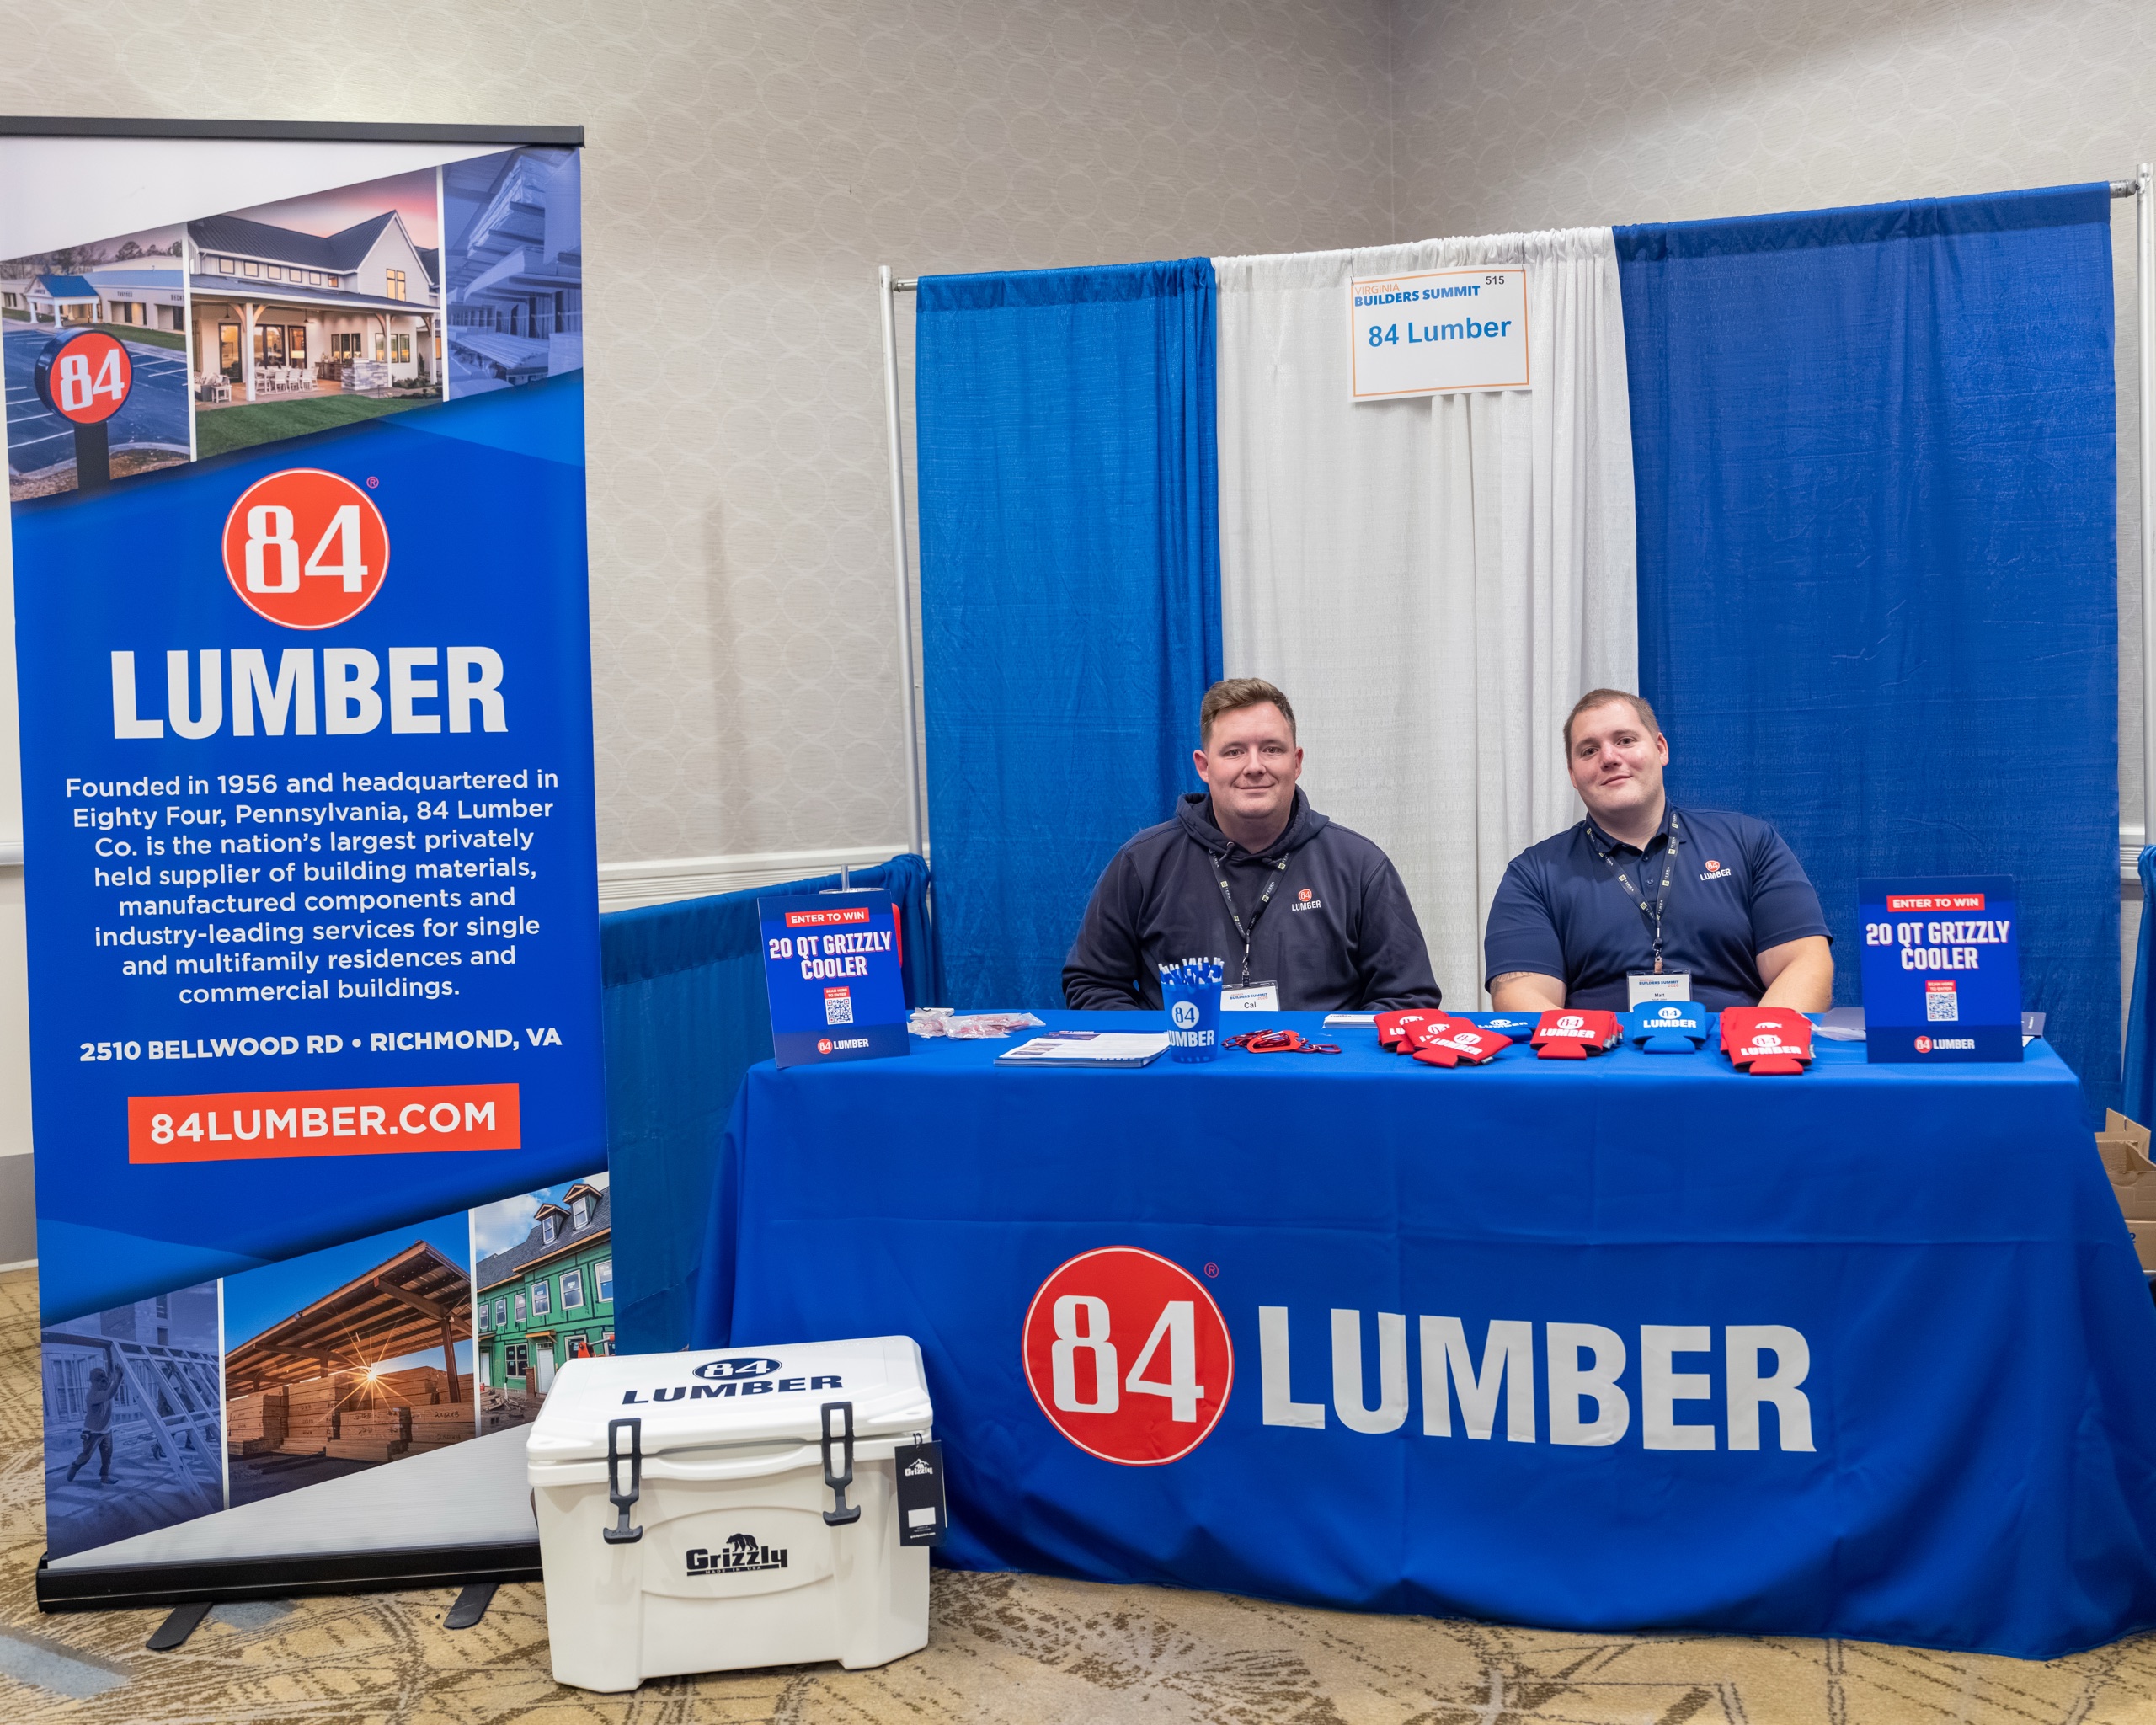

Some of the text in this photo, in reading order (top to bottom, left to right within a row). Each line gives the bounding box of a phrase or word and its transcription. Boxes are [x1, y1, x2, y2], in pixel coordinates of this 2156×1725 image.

[1355, 283, 1400, 296] VIRGINIA
[1486, 275, 1505, 286] 515
[1354, 286, 1481, 307] BUILDERS SUMMIT
[1369, 317, 1512, 347] 84 Lumber
[60, 349, 125, 412] 84
[245, 505, 368, 594] 84
[111, 646, 508, 740] LUMBER
[66, 769, 558, 798] Founded in 1956 and headquartered in
[73, 798, 553, 830] Eighty Four, Pennsylvania, 84 Lumber
[95, 828, 534, 857] Co. is the nation’s largest privately
[94, 857, 536, 888] held supplier of building materials,
[1700, 868, 1732, 881] LUMBER
[120, 886, 515, 916] manufactured components and
[1291, 900, 1321, 911] LUMBER
[1300, 890, 1310, 900] 84
[1892, 897, 1979, 909] ENTER TO WIN
[791, 911, 865, 924] ENTER TO WIN
[95, 915, 540, 948] industry-leading services for single
[1865, 921, 2011, 948] 20 QT GRIZZLY
[768, 931, 893, 960] 20 QT GRIZZLY
[122, 945, 515, 975] and multifamily residences and
[801, 955, 868, 980] COOLER
[1900, 947, 1980, 970] COOLER
[179, 977, 460, 1004] commercial buildings.
[1175, 1007, 1195, 1023] 84
[1561, 1017, 1579, 1026] 84
[1643, 1019, 1697, 1028] LUMBER
[79, 1028, 563, 1062] 2510 BELLWOOD RD RICHMOND, VA
[818, 1038, 869, 1052] 84 LUMBER
[1167, 1029, 1214, 1047] UMBER
[1540, 1028, 1596, 1039] LUMBER
[1916, 1039, 1975, 1049] 84 LUMBER
[1741, 1045, 1802, 1056] LUMBER
[150, 1101, 496, 1145] 84LUMBER.COM
[704, 1359, 771, 1378] 84
[1051, 1294, 1817, 1453] 84 LUMBER
[622, 1375, 845, 1405] LUMBER
[905, 1467, 933, 1477] Grizzly
[686, 1546, 788, 1570] Grizzly
